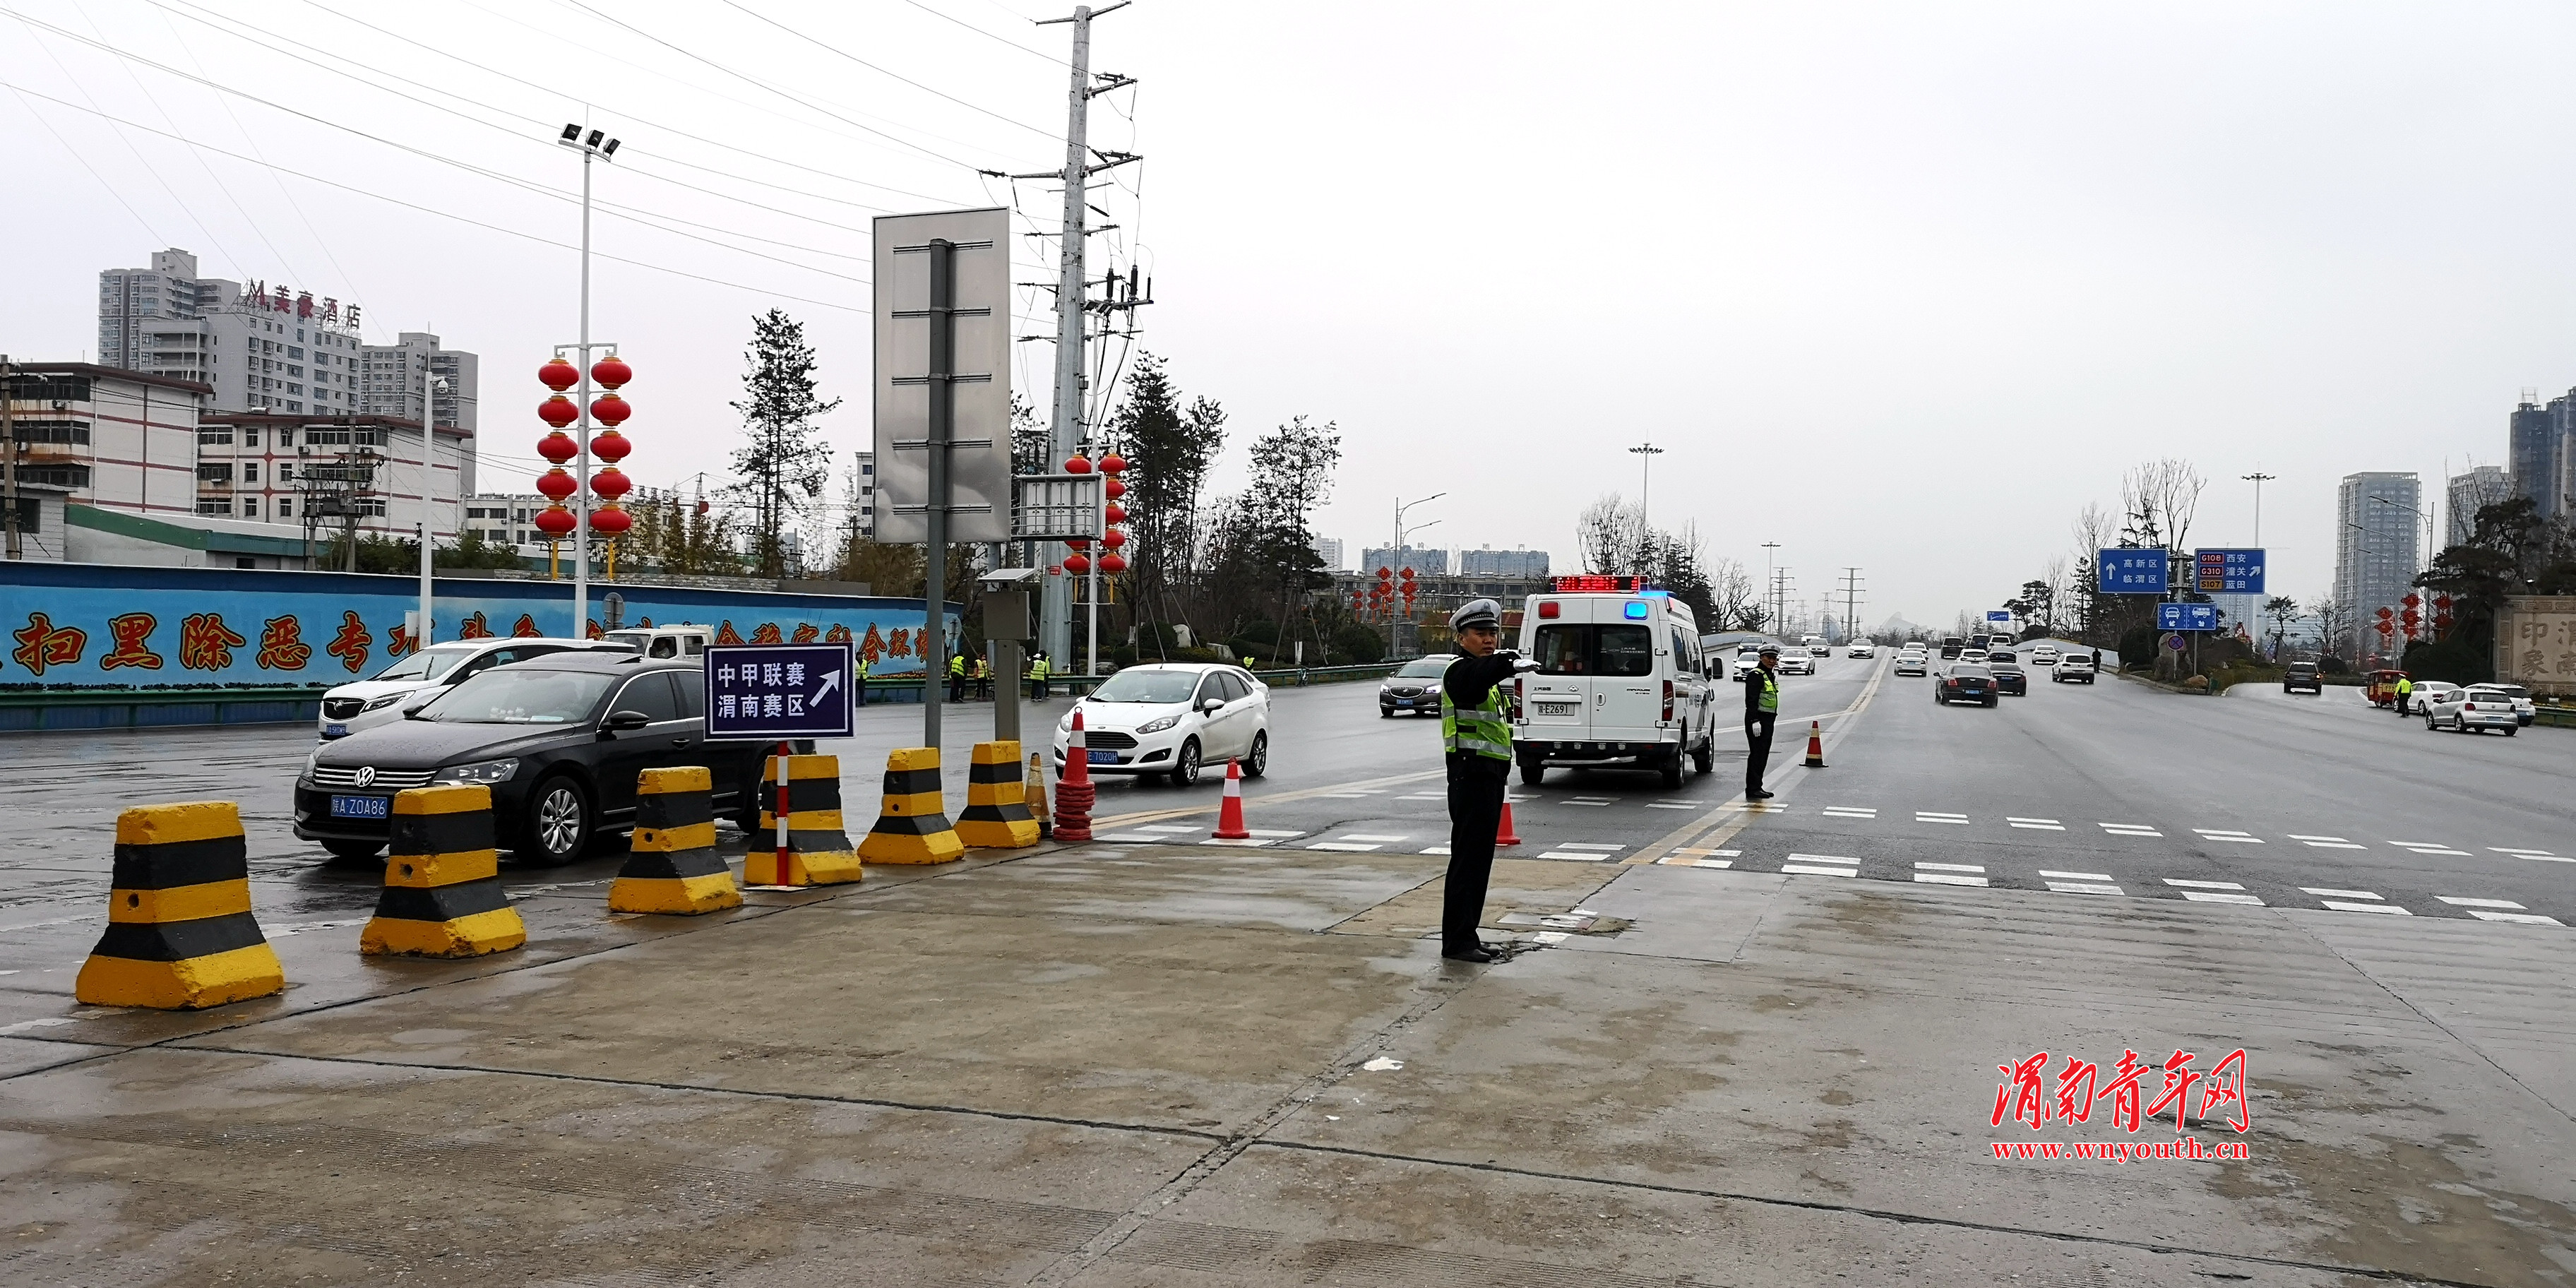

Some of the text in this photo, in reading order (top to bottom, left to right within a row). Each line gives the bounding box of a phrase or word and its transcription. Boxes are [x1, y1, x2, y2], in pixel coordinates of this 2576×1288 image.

[273, 284, 362, 330] 美豪酒店
[2123, 559, 2157, 569] 高新区
[2226, 554, 2246, 564] 西安
[2226, 566, 2246, 576] 潼关
[2123, 574, 2158, 584] 临渭区
[2225, 580, 2246, 590] 蓝田
[718, 662, 805, 688] 中甲联赛
[717, 693, 805, 718] 渭南赛区
